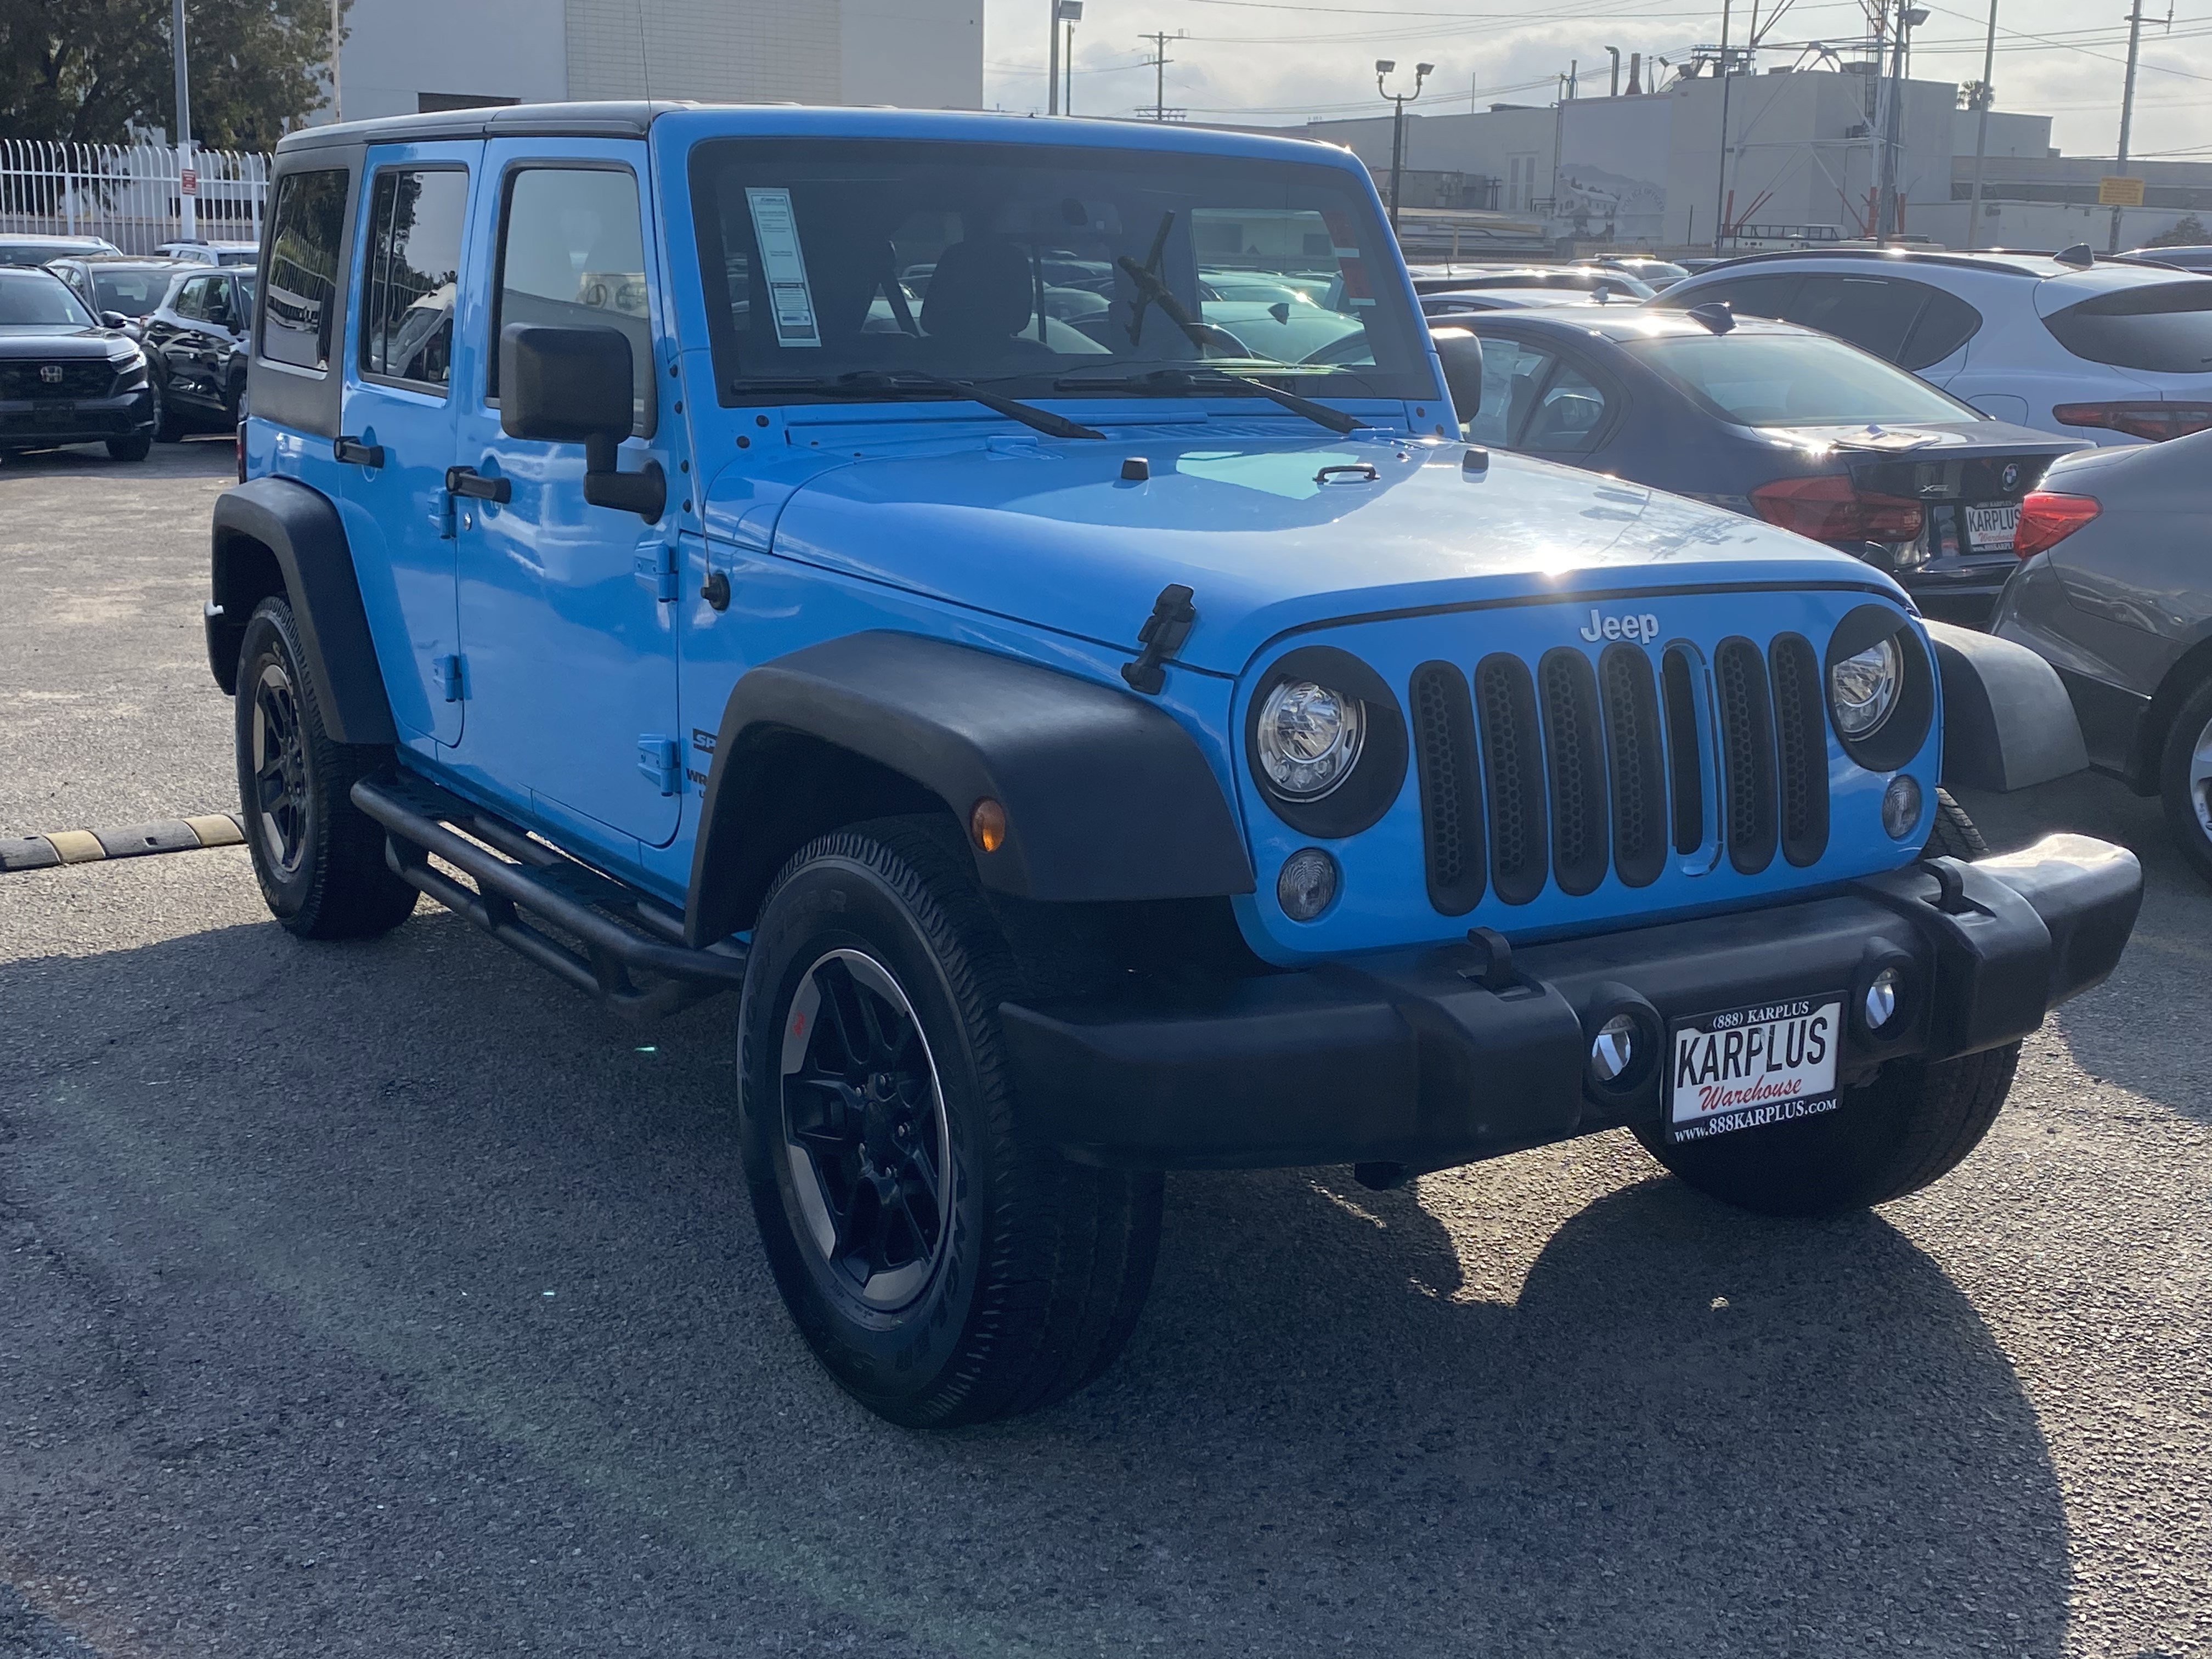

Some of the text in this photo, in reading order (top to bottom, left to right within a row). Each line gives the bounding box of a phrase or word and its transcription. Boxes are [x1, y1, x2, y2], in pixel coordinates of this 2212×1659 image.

[1580, 609, 1659, 645] Jeep
[1713, 1001, 1810, 1029] (888) KARPLUS
[1677, 1017, 1828, 1088] KARPLUS
[1699, 1074, 1802, 1111] Warehouse
